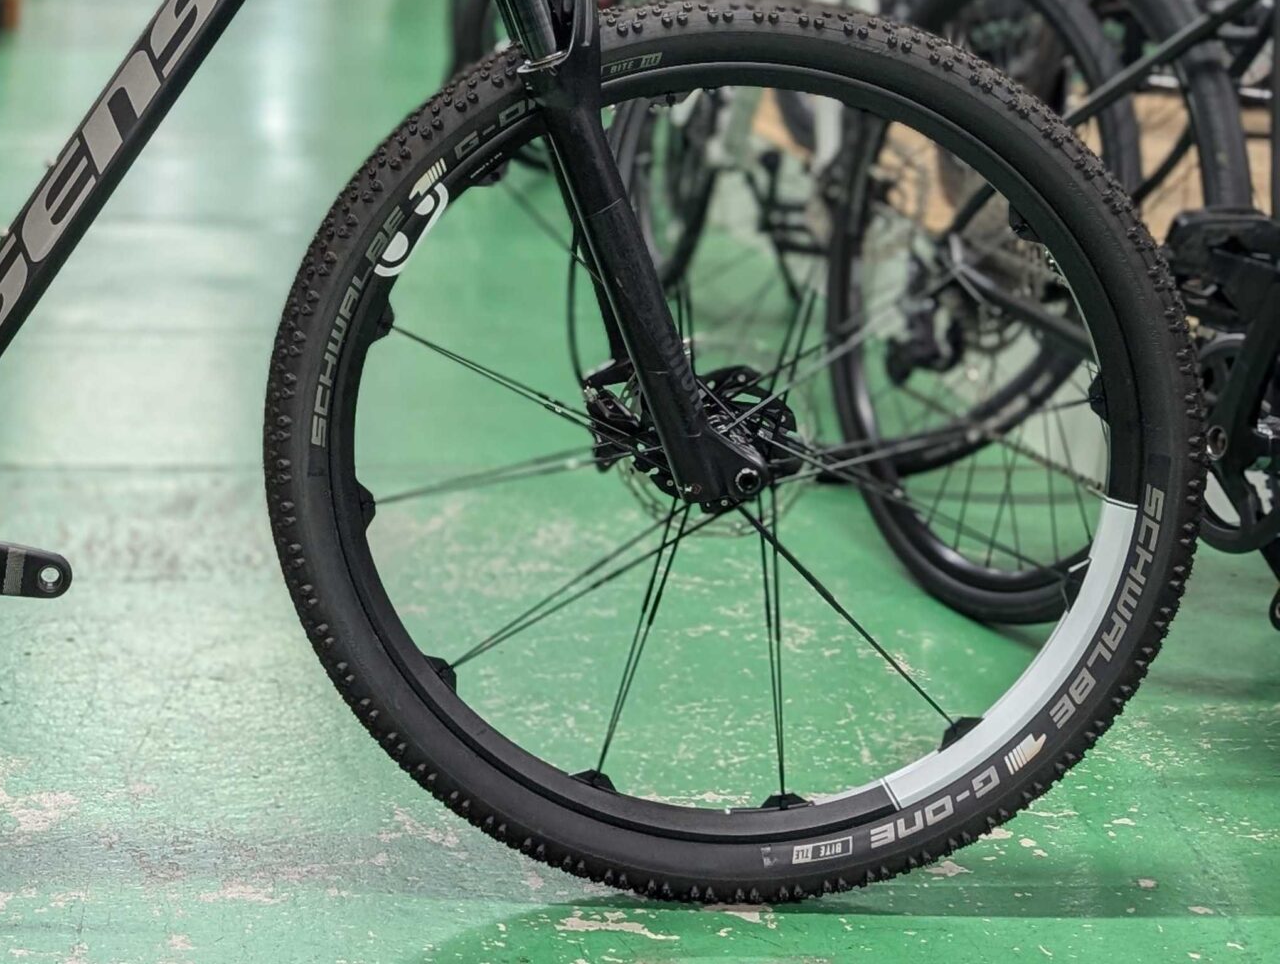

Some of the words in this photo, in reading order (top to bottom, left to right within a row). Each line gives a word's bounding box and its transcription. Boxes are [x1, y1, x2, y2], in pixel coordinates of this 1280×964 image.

[310, 205, 406, 448] SCHWALBE
[1049, 483, 1165, 729] SCHWALBE
[819, 842, 842, 857] BITE
[870, 765, 1001, 849] G-ONE
